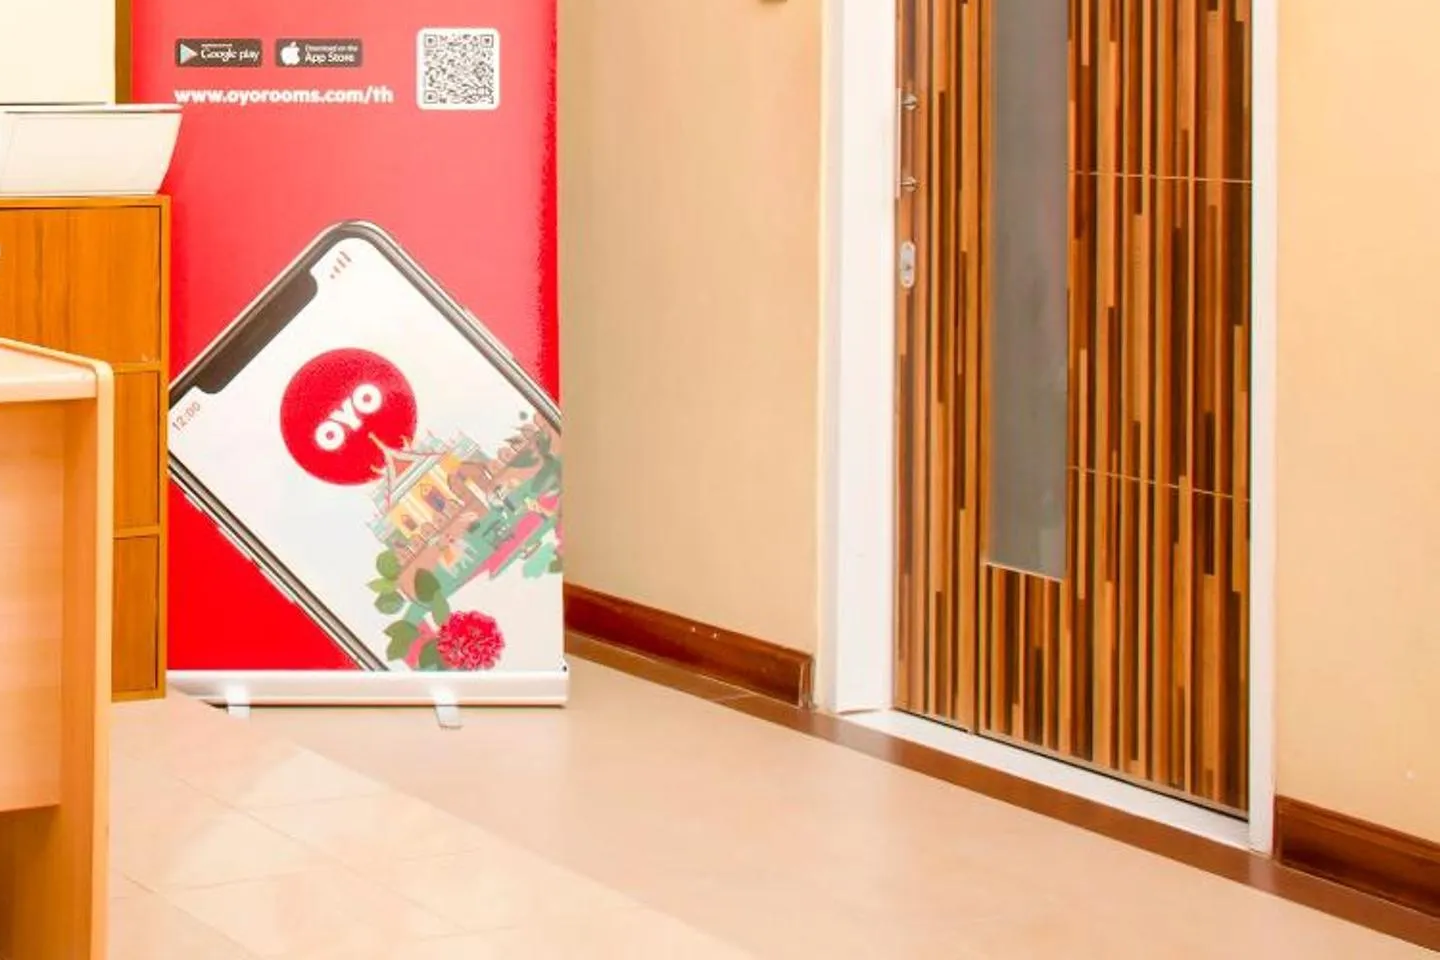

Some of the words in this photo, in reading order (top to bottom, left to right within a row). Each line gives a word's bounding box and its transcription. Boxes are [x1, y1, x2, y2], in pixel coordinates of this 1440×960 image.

[200, 47, 238, 62] Google
[239, 47, 261, 63] play
[304, 51, 327, 63] App
[327, 51, 355, 63] Store
[173, 85, 394, 106] www.oyorooms.com/th
[171, 401, 201, 431] 12:00
[313, 382, 382, 451] OYO
